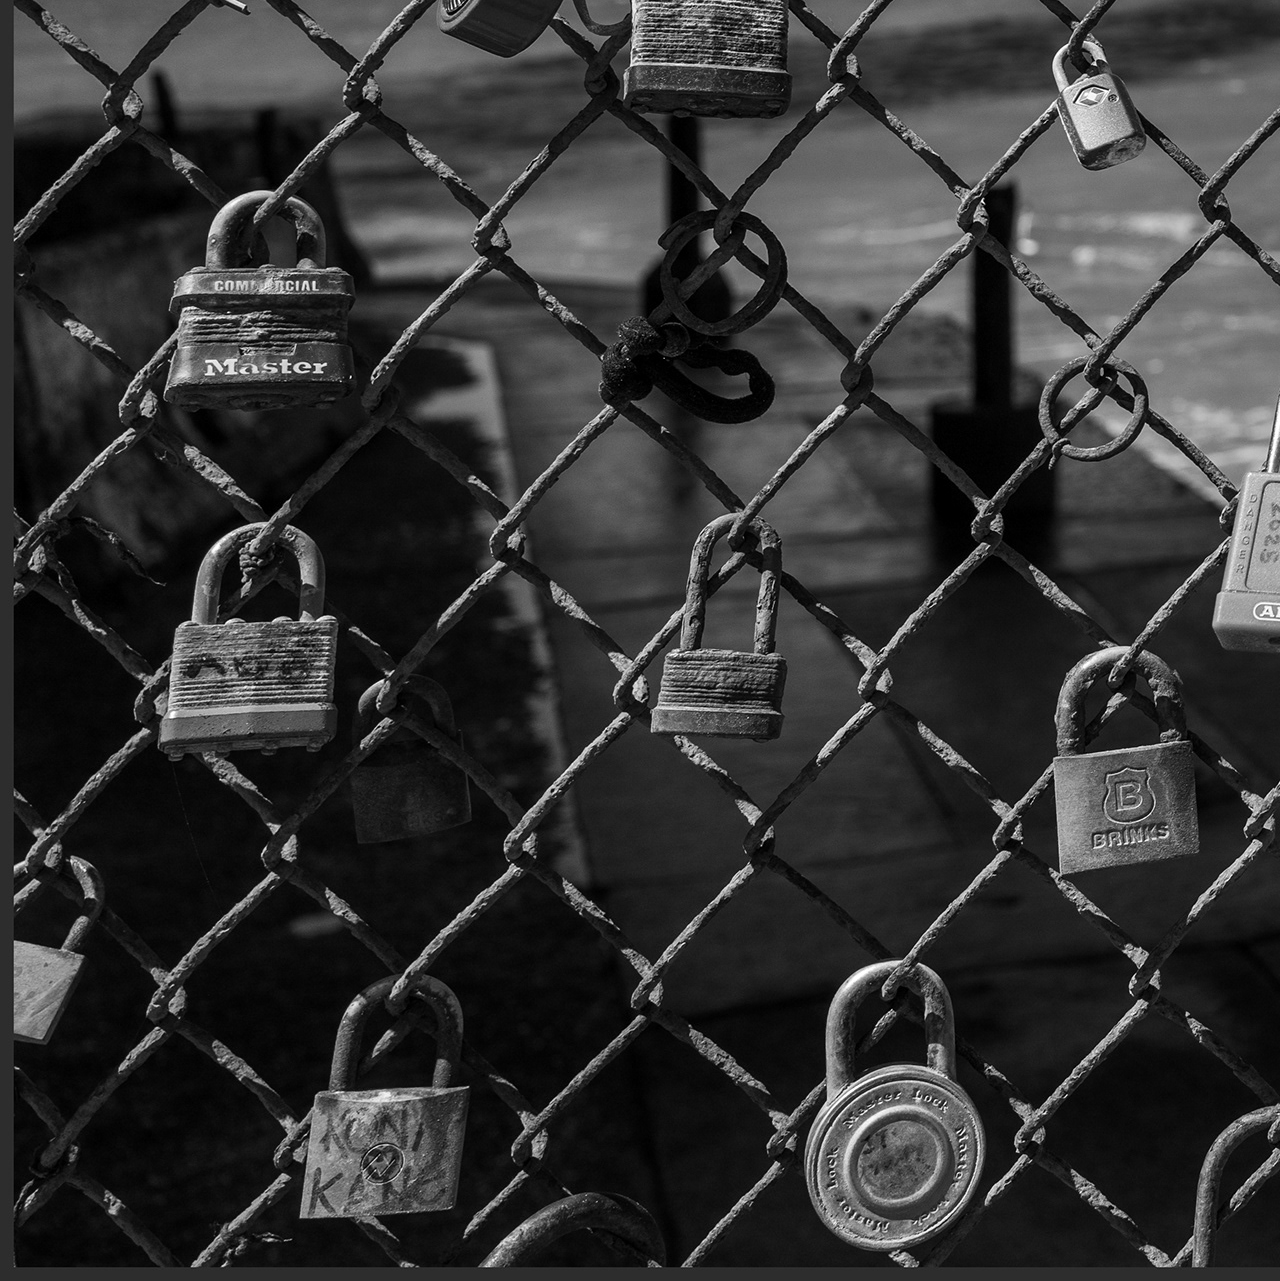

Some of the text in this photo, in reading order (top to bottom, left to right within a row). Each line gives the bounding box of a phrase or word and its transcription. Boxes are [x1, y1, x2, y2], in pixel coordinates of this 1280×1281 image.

[214, 280, 320, 292] COMRCIAL
[204, 359, 328, 376] Master
[1236, 494, 1258, 574] DANGER
[1114, 781, 1144, 812] B
[1092, 823, 1171, 850] BRINKS
[843, 1087, 949, 1130] Master Lock
[826, 1146, 839, 1191] Lock
